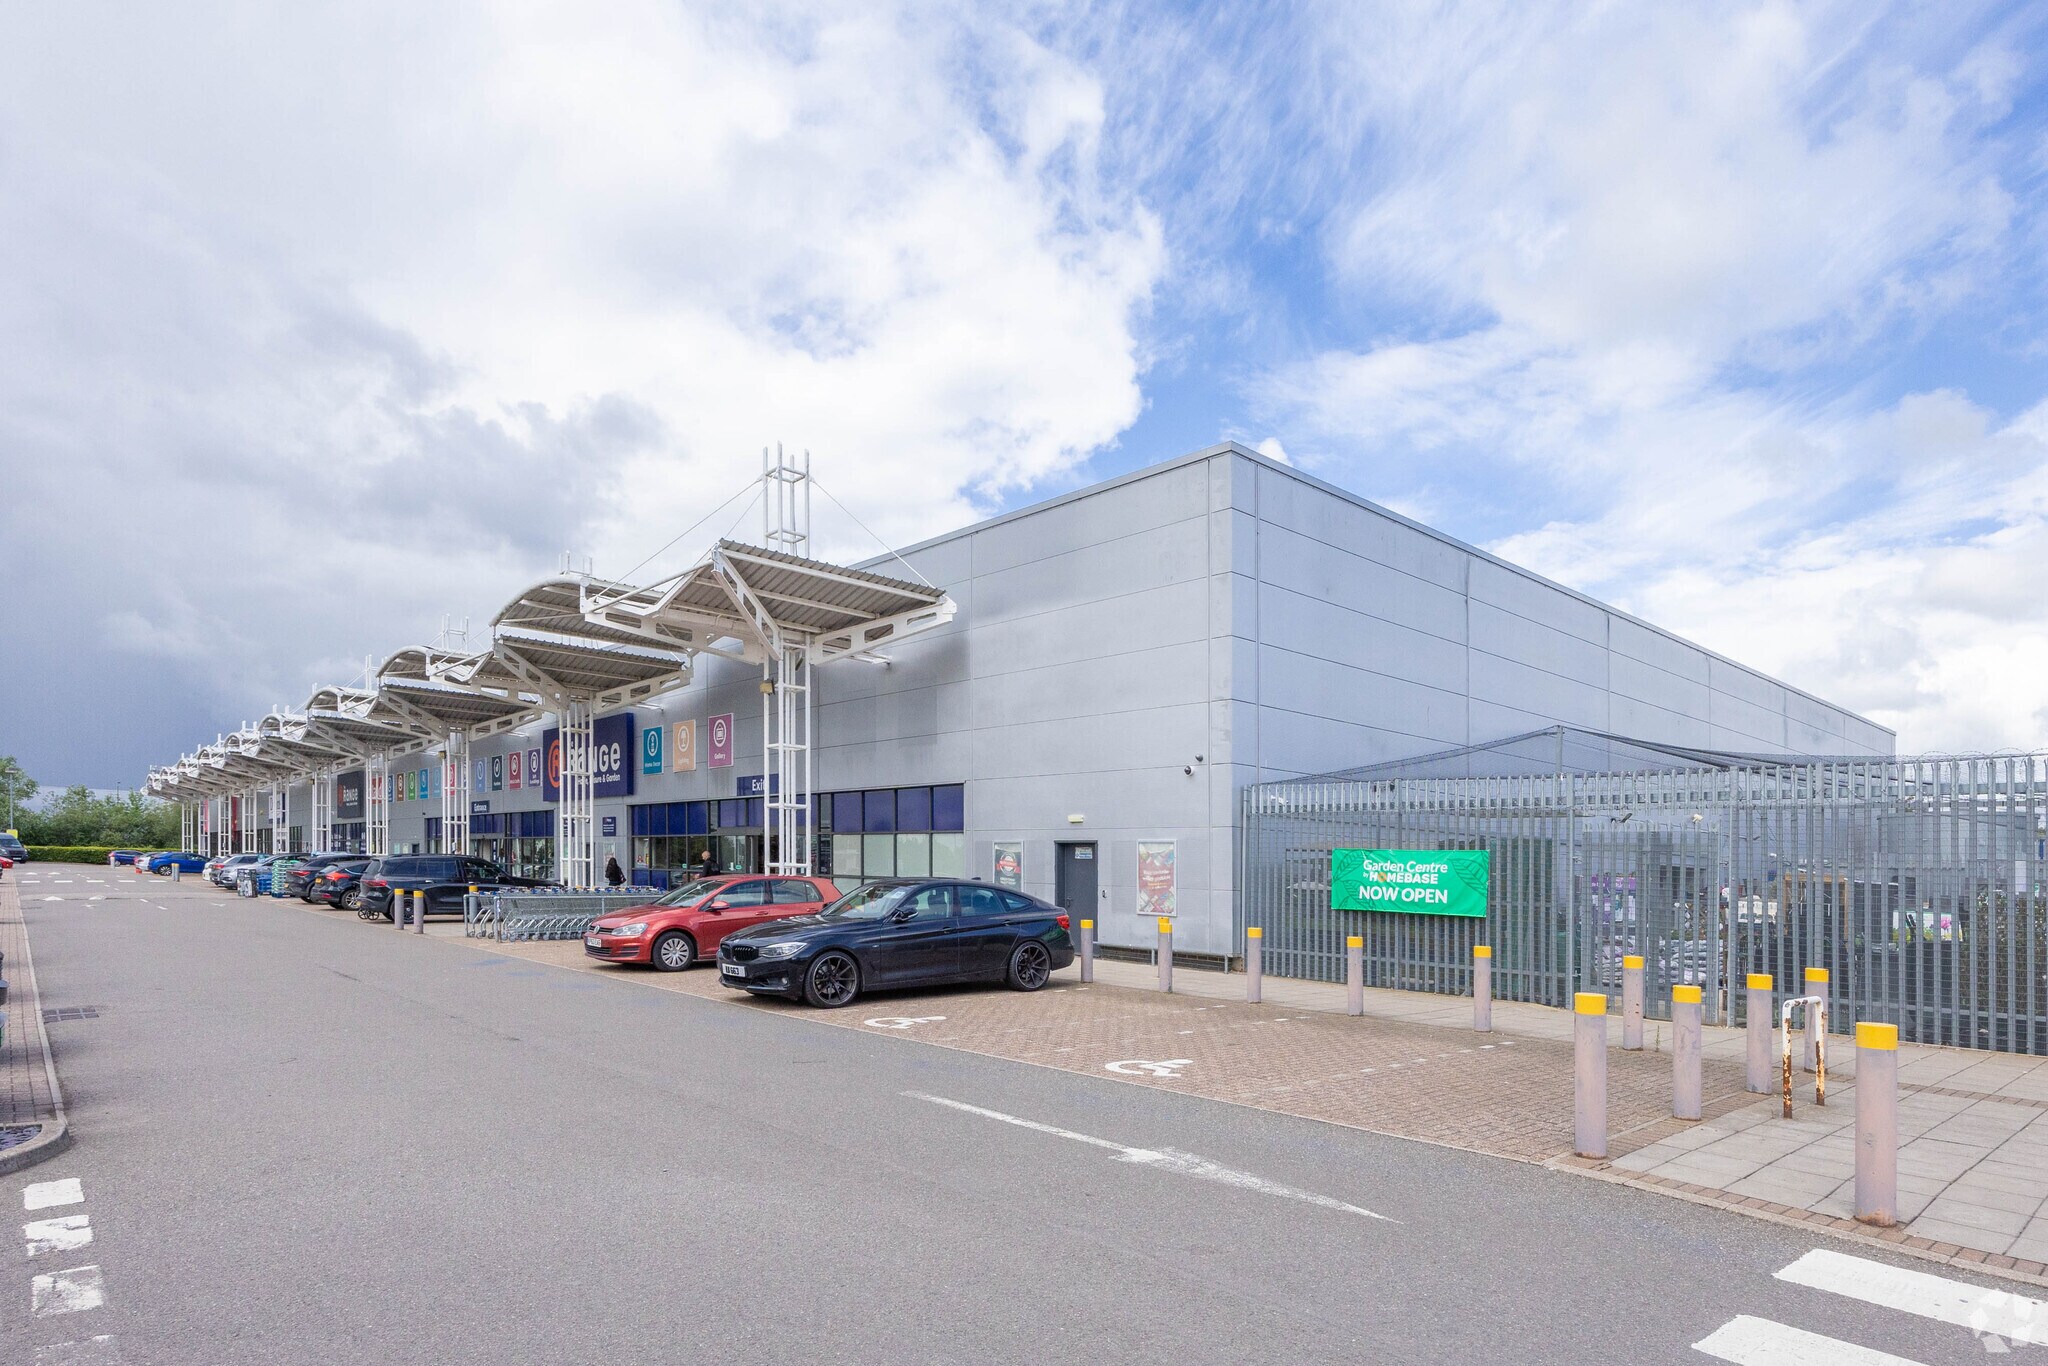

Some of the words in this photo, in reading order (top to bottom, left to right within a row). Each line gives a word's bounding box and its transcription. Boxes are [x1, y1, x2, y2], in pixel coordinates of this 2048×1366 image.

[606, 773, 621, 783] Garden
[1363, 860, 1404, 872] Garden
[1406, 861, 1448, 873] Centre
[1370, 872, 1438, 884] HOMEBASE
[1359, 886, 1399, 901] NOW
[1401, 888, 1448, 904] OPEN
